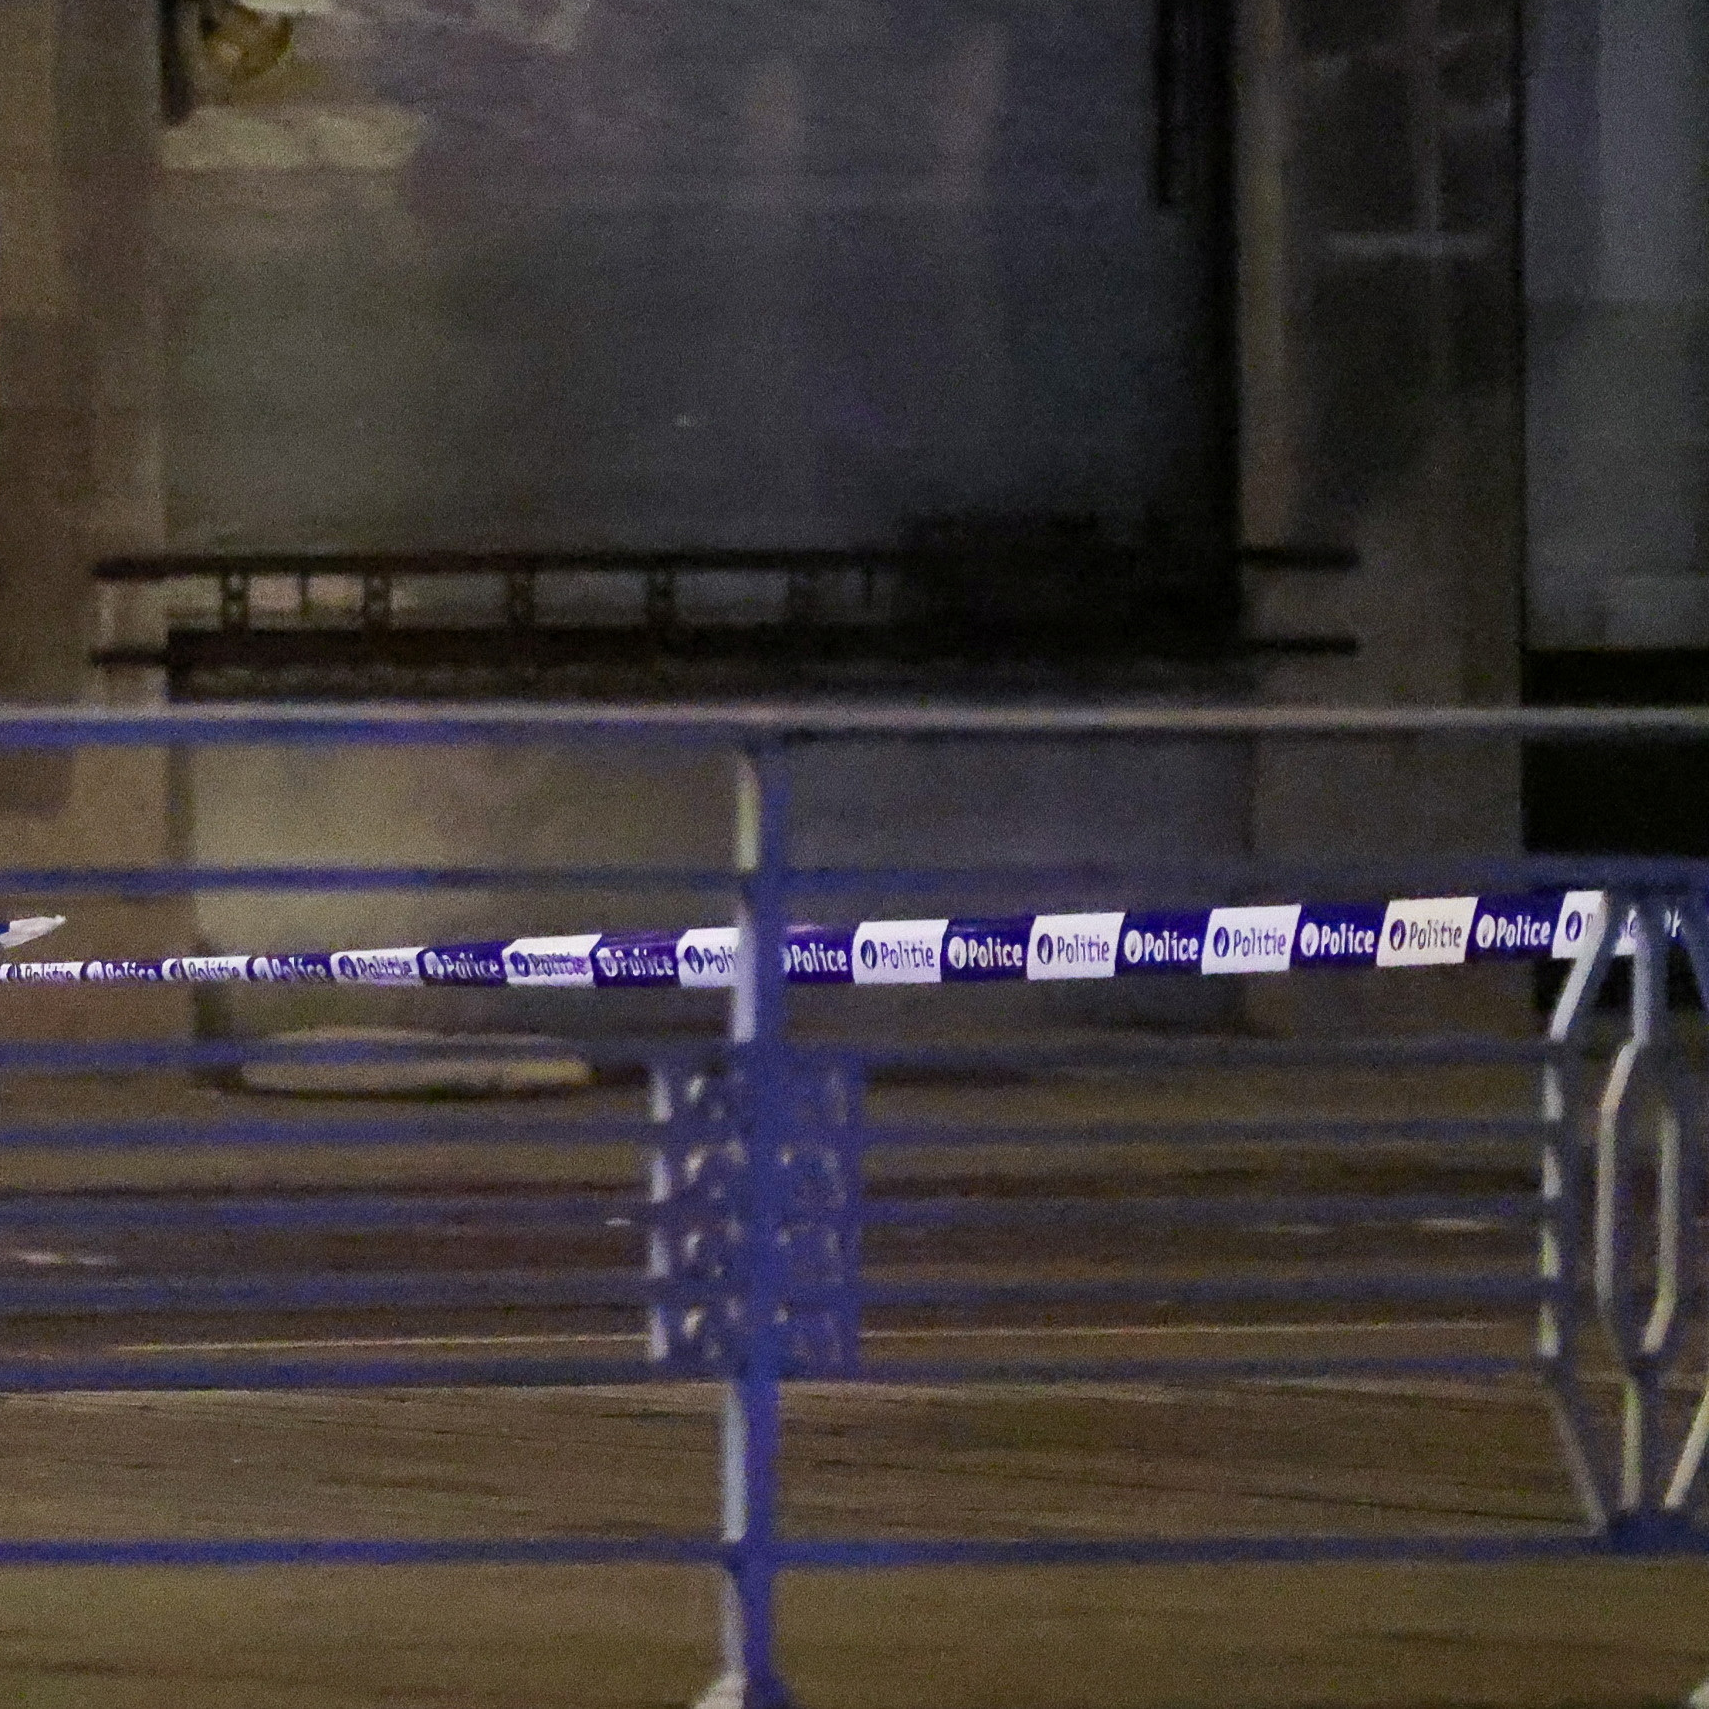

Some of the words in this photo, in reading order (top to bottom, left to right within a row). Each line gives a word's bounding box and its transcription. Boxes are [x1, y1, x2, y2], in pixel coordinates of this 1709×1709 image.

[791, 942, 848, 973] Police
[880, 940, 935, 969] Politie
[968, 937, 1023, 968] Police
[1056, 933, 1110, 964] Politie
[1144, 930, 1199, 962] Police
[1233, 927, 1287, 958] Politie
[1320, 922, 1375, 955] Police
[1409, 919, 1463, 951] Politie
[1496, 915, 1552, 948] Police
